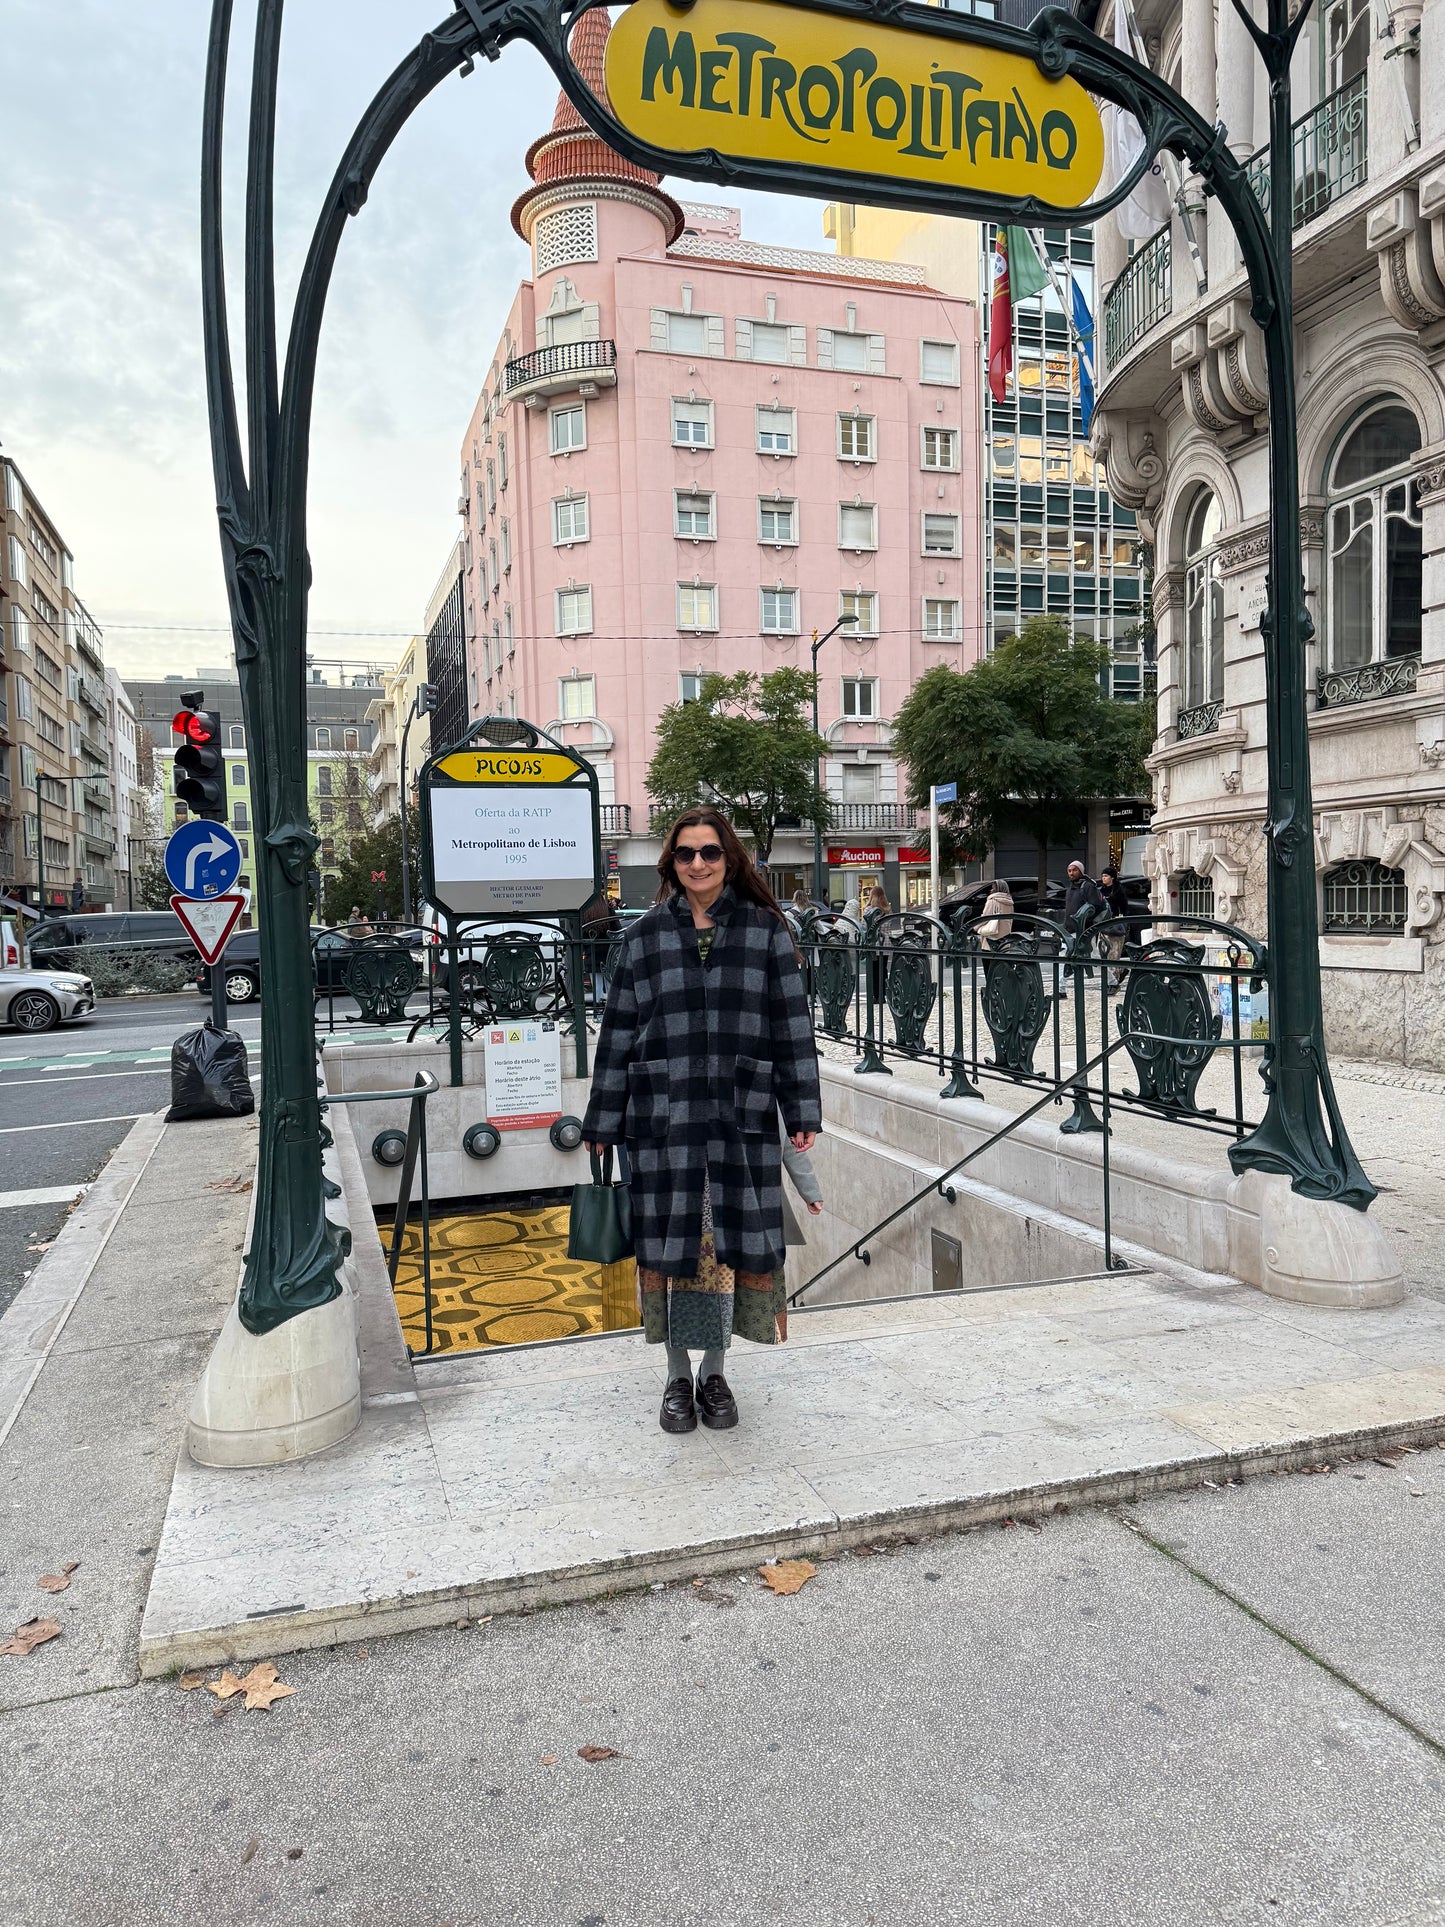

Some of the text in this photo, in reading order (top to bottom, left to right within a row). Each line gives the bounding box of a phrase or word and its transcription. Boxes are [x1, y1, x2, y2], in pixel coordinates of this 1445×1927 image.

[640, 26, 1077, 169] METROPOLITANO
[476, 759, 542, 776] PICOAS
[474, 807, 552, 817] Oferta da RATP
[508, 826, 520, 835] ao
[451, 838, 577, 851] Metropolitano de Lisboa
[504, 854, 528, 864] 1995
[841, 849, 881, 861] Auchan
